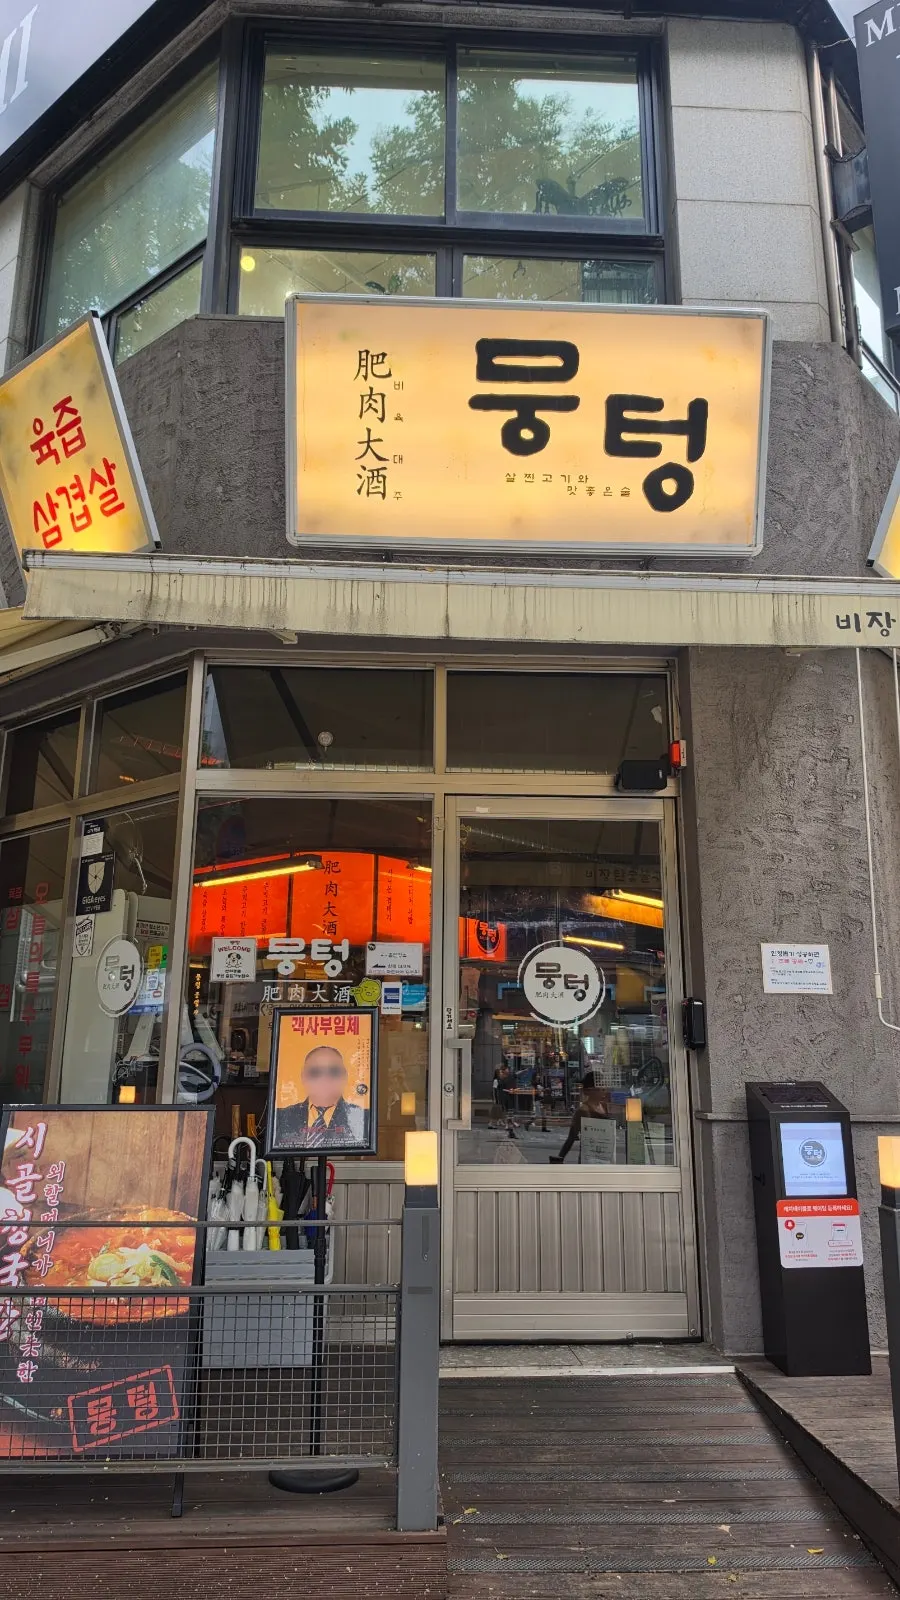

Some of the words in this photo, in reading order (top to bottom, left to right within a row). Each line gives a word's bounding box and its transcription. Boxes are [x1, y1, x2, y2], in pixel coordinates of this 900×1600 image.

[30, 395, 86, 466] 육즙
[353, 349, 392, 500] 肥肉大酒
[468, 338, 708, 512] 뭉텅
[33, 457, 125, 549] 삼겹살
[836, 611, 896, 637] 비장
[266, 937, 351, 979] 뭉텅
[534, 962, 590, 1002] 뭉텅
[261, 984, 352, 1003] 肥肉大酒
[291, 1016, 360, 1036] 객사부일체
[86, 1381, 160, 1436] 뭉텅
